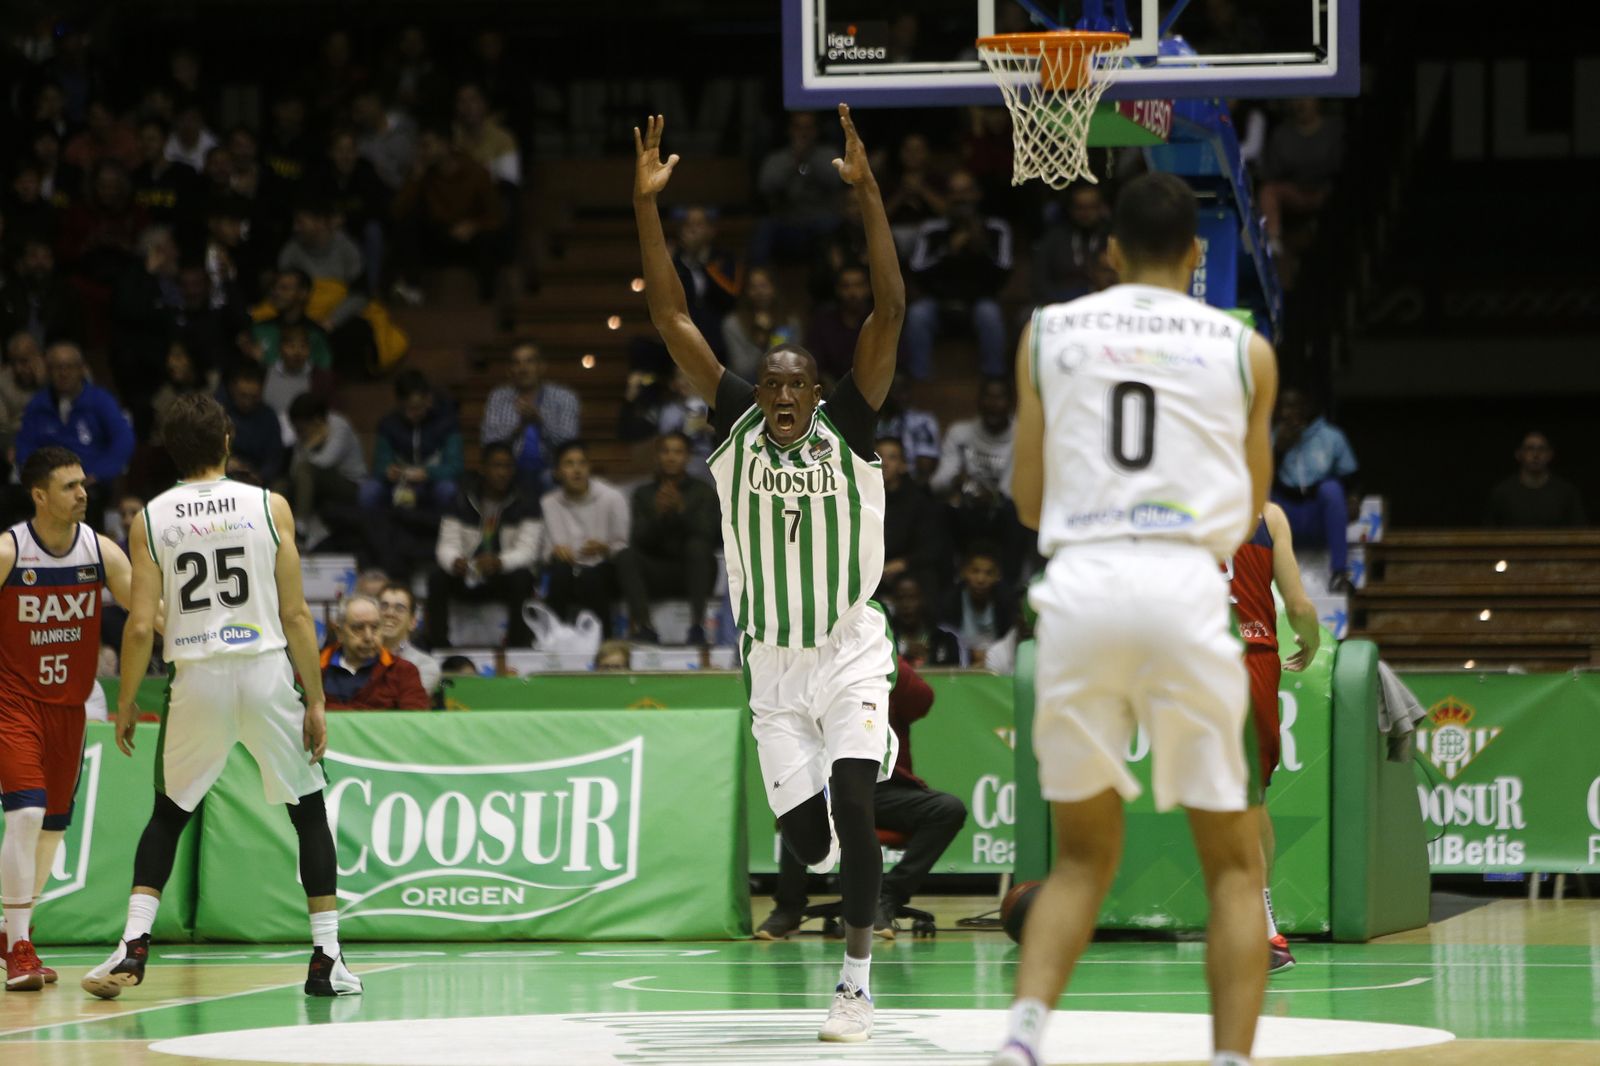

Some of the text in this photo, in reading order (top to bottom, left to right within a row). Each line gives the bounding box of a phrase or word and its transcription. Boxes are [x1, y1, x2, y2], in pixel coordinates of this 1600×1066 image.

[827, 33, 855, 48] liga
[827, 46, 886, 60] endesa
[1105, 380, 1156, 474] 0
[748, 456, 838, 494] COOSUR
[175, 497, 236, 518] SIPAHI
[784, 509, 801, 543] 7
[174, 546, 250, 614] 25
[18, 590, 97, 624] BAXI
[223, 627, 251, 641] plus
[38, 654, 70, 686] 55
[1416, 776, 1527, 830] OSUR
[326, 776, 623, 877] COOSUR
[401, 886, 525, 906] ORIGEN
